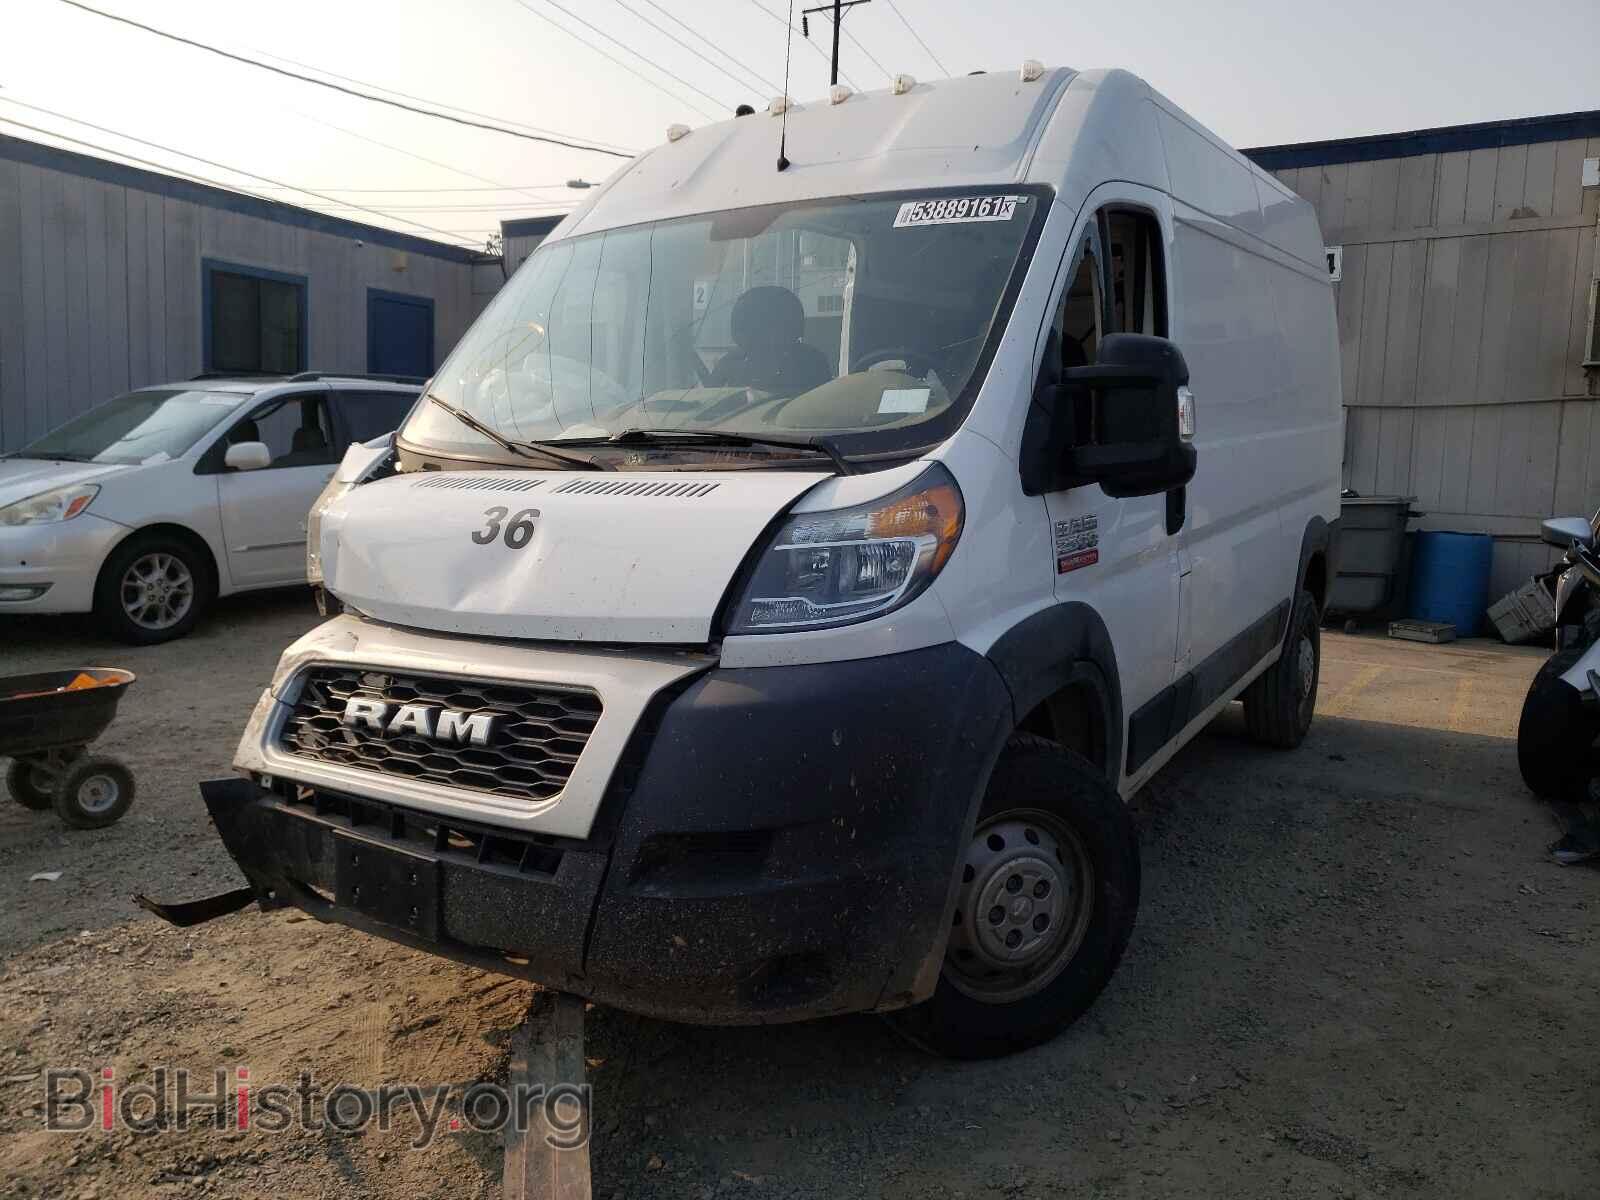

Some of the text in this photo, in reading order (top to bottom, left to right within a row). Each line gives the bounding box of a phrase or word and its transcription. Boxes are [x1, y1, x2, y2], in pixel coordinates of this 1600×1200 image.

[911, 197, 1004, 221] 53889161
[696, 286, 705, 304] 2
[472, 505, 541, 550] 36
[343, 698, 494, 746] RAM
